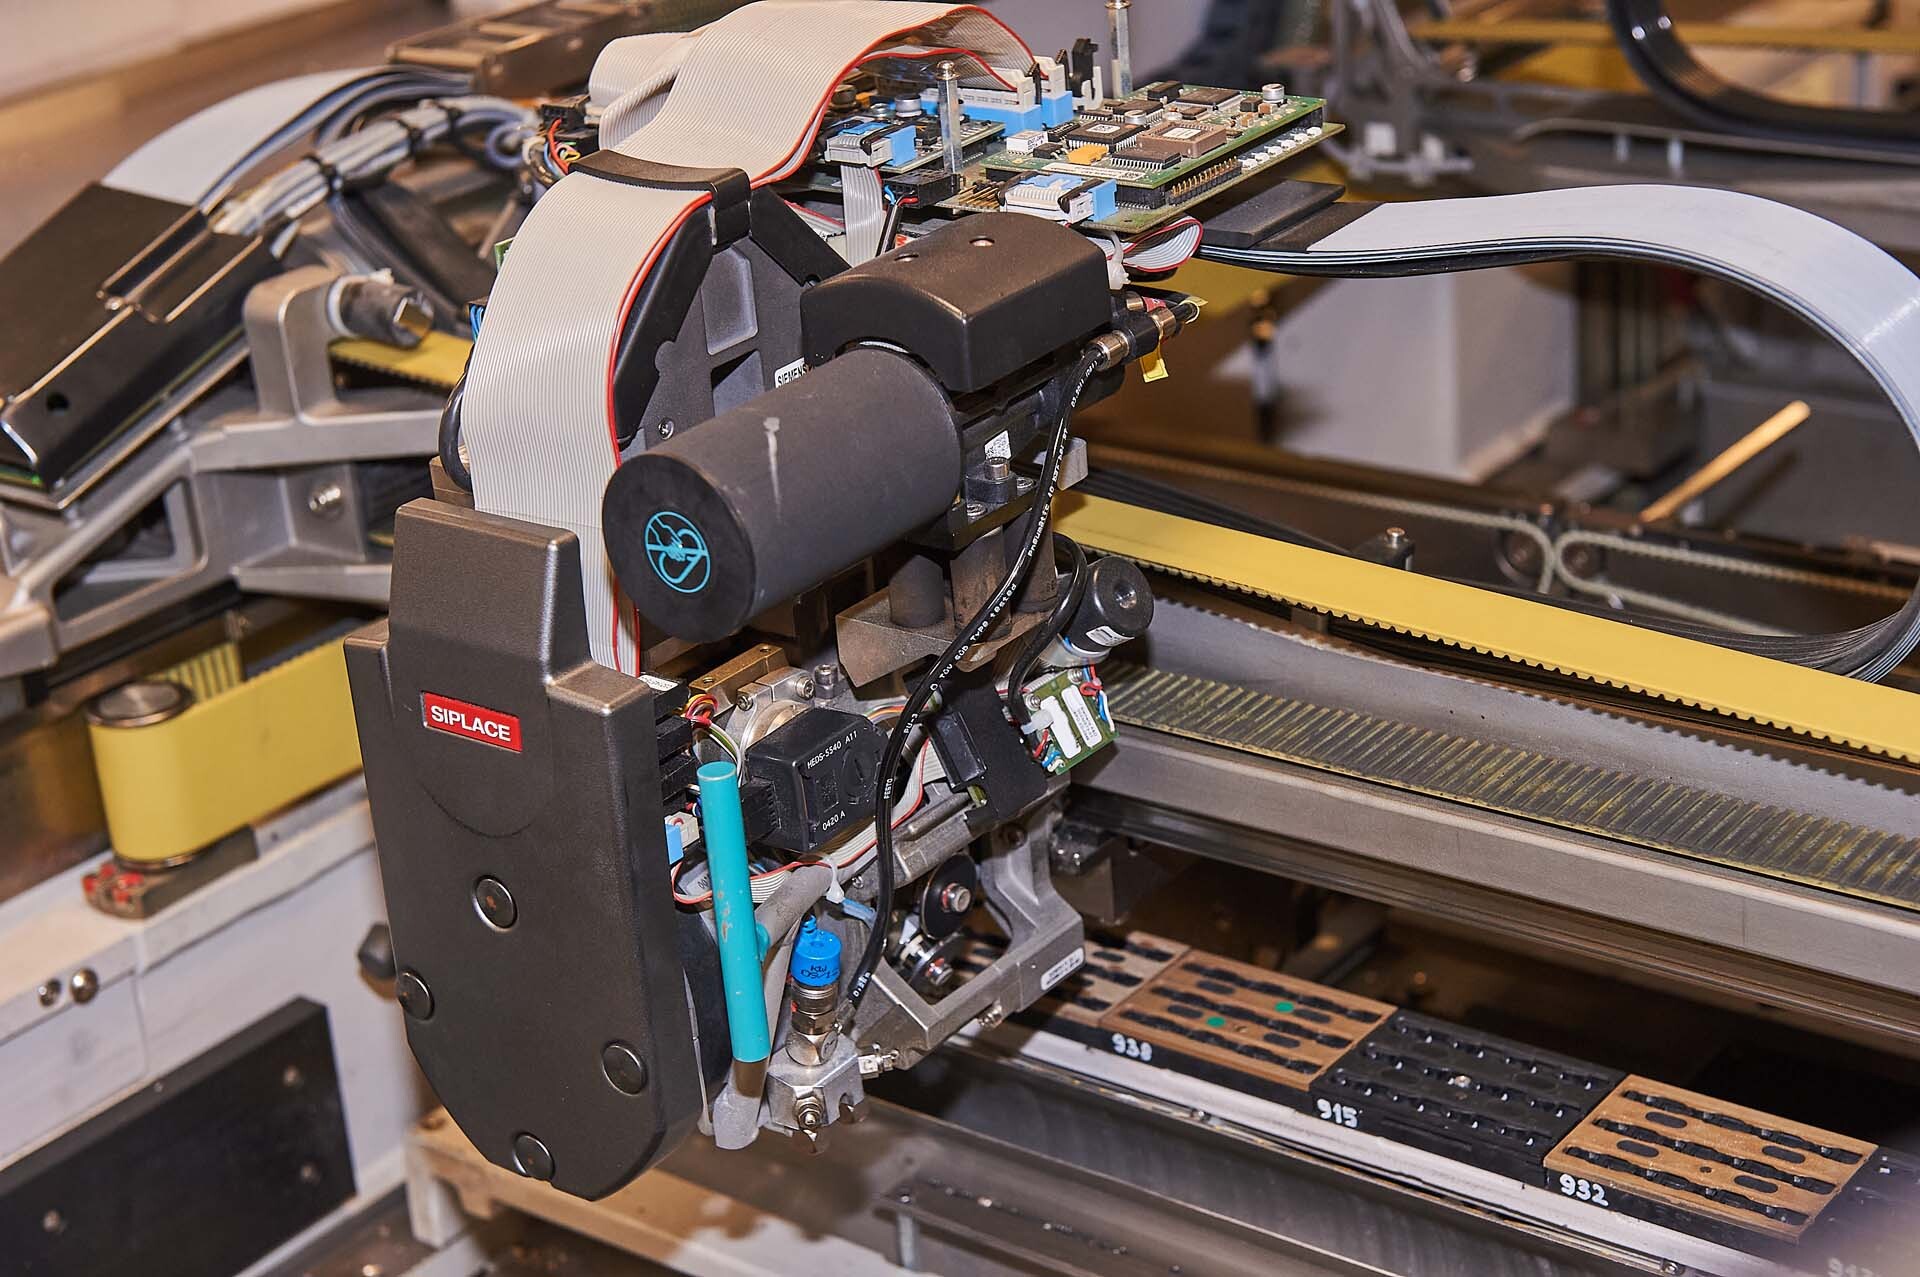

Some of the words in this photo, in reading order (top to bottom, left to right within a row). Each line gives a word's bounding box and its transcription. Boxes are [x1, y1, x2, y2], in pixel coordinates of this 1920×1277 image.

[777, 363, 808, 387] SIEMENS
[883, 778, 894, 800] FESTO
[903, 713, 919, 734] PU-3
[990, 583, 1017, 618] tested
[430, 705, 511, 742] SIPLACE
[806, 740, 842, 770] HEDS-5540
[844, 730, 858, 744] A11
[822, 814, 839, 831] 0420
[840, 810, 846, 820] A
[1317, 1098, 1358, 1128] 915
[1559, 1173, 1609, 1207] 932
